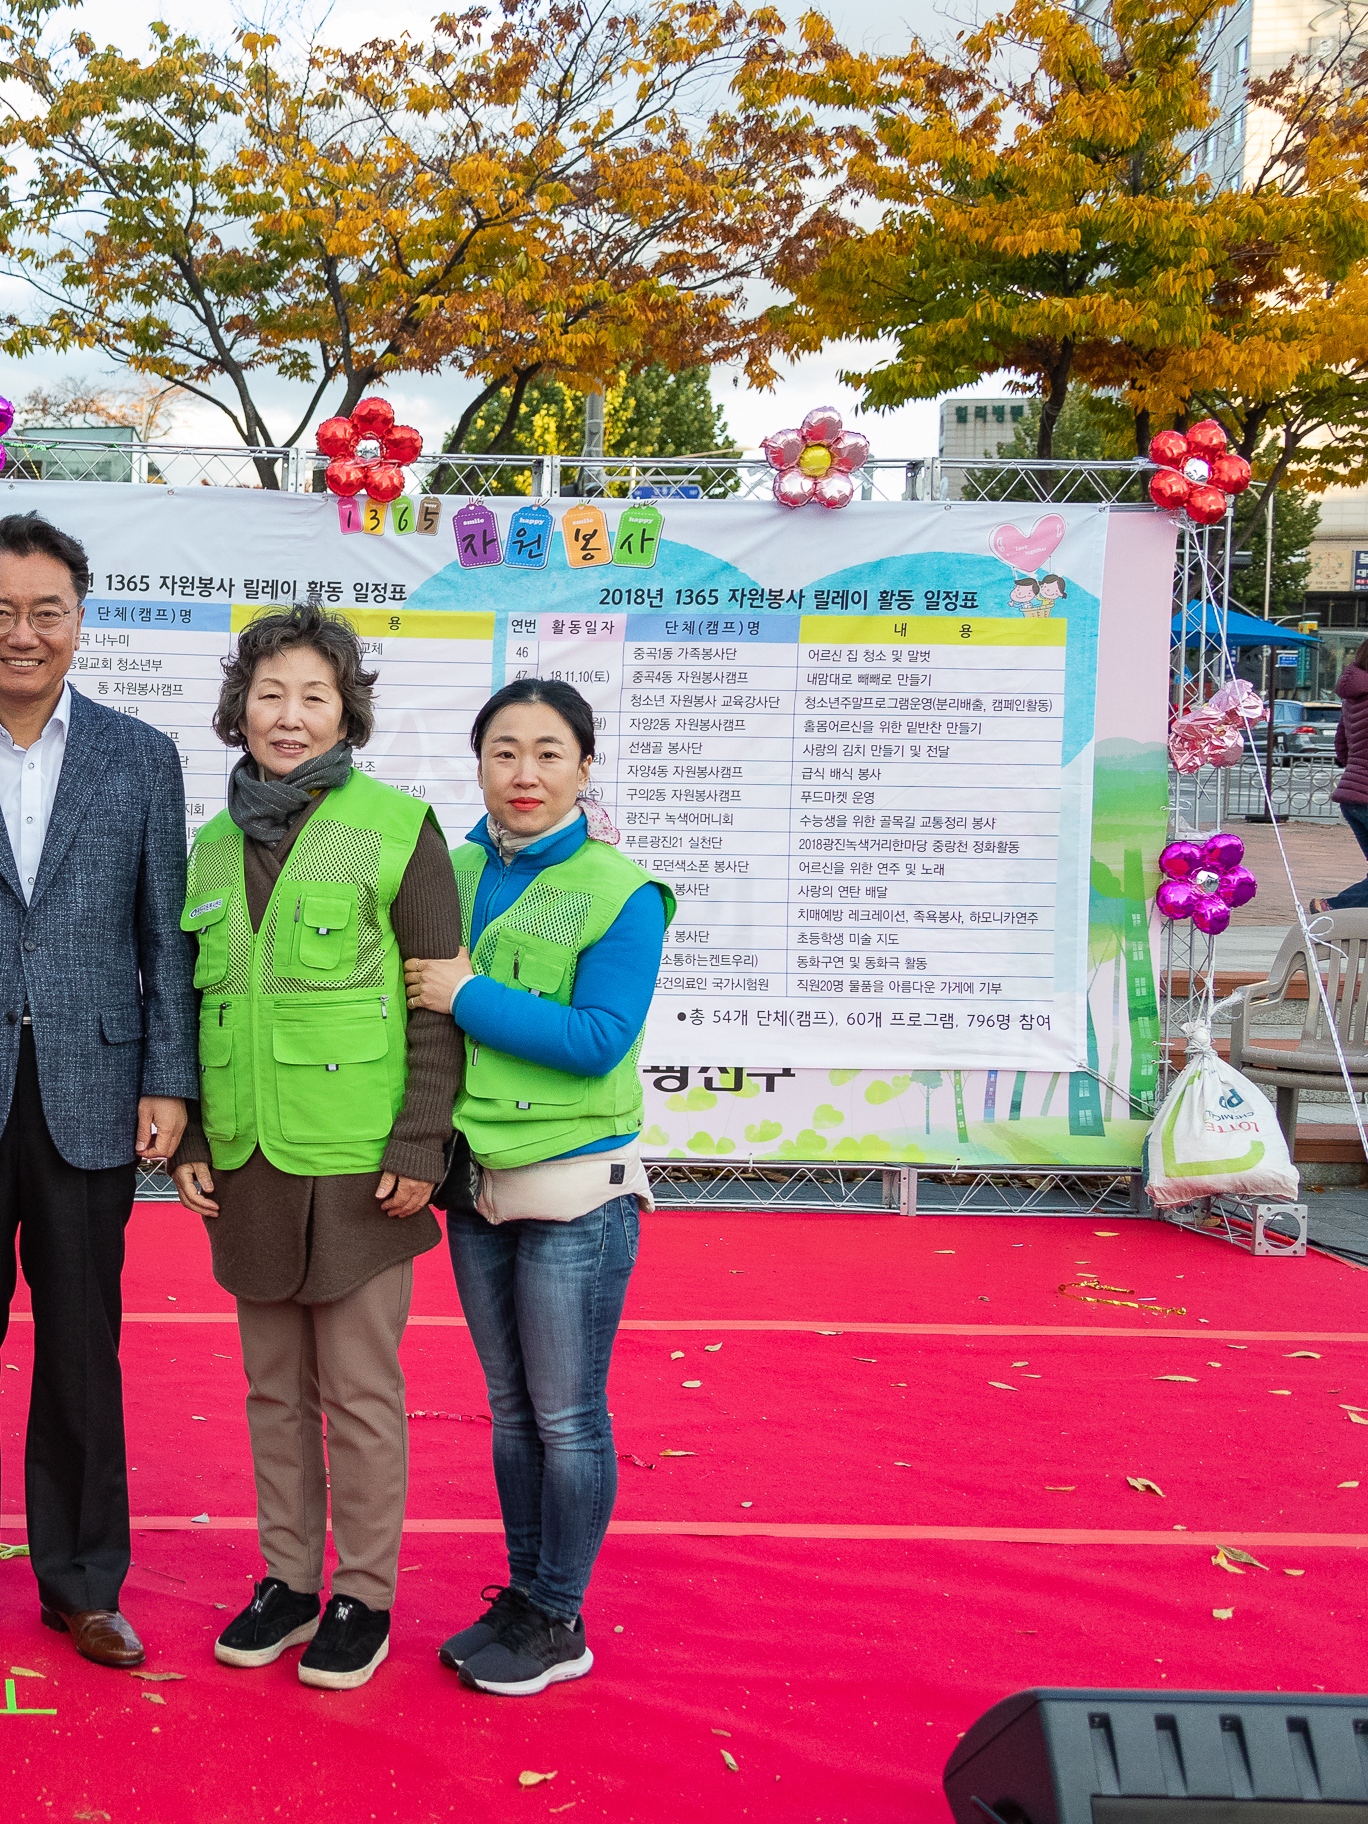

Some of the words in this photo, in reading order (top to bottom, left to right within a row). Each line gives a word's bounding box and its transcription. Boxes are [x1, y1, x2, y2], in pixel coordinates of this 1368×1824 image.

[106, 574, 150, 592] 1365
[159, 575, 235, 598] 자원봉사
[244, 579, 297, 600] 릴레이
[306, 580, 343, 604] 활동
[353, 582, 407, 603] 일정표
[599, 588, 663, 608] 2018년
[676, 589, 718, 605] 1365
[728, 588, 806, 610] 자원봉사
[814, 589, 867, 610] 릴레이
[878, 590, 915, 611] 활동
[924, 590, 979, 613] 일정표
[512, 619, 536, 633] 연번
[96, 634, 129, 647] 나누미
[516, 647, 528, 658] 46
[633, 648, 673, 660] 중곡1동
[677, 648, 737, 660] 가족봉사단
[809, 650, 842, 662] 어르신
[847, 650, 857, 662] 집
[863, 650, 886, 662] 청소
[892, 650, 902, 662] 및
[908, 650, 930, 662] 말벗
[117, 658, 162, 672] 청소년부
[807, 673, 852, 685] 내맘대로
[858, 673, 892, 686] 빼빼로
[898, 674, 931, 686] 만들기
[114, 682, 183, 696] 자원봉사캠프
[631, 694, 664, 707] 청소년
[670, 695, 717, 708] 자원봉사
[721, 695, 780, 708] 교육강사단
[804, 720, 874, 733] 홀몸어르신을
[879, 721, 902, 733] 위한
[907, 721, 942, 734] 밑반찬
[947, 722, 981, 735] 만들기
[629, 741, 663, 754] 선샘골
[668, 742, 703, 754] 봉사단
[801, 791, 847, 804] 푸드마켓
[852, 791, 874, 804] 운영
[626, 812, 660, 824] 광진구
[665, 813, 733, 826] 녹색어머니회
[800, 815, 847, 827] 수능생을
[852, 815, 875, 827] 위한
[880, 816, 915, 828] 골목길
[920, 816, 967, 829] 교통정리
[972, 817, 997, 830] 봉사
[626, 836, 682, 848] 푸른광진21
[688, 836, 723, 849] 실천단
[799, 839, 928, 852] 2018광진녹색거리한마당
[932, 840, 967, 853] 중랑천
[973, 841, 1020, 854] 정화활동
[652, 860, 709, 872] 모던색소폰
[714, 861, 749, 873] 봉사단
[798, 885, 832, 898] 사랑의
[838, 886, 861, 898] 연탄
[866, 886, 888, 898] 배달
[798, 909, 844, 922] 치매예방
[970, 911, 1038, 924] 하모니카연주
[797, 932, 843, 945] 초등학생
[849, 933, 872, 945] 미술
[877, 933, 899, 945] 지도
[712, 978, 768, 991] 국가시험원
[797, 979, 843, 992] 직원20명
[849, 980, 884, 993] 물품을
[889, 981, 935, 993] 아름다운
[940, 982, 974, 994] 가게에
[979, 982, 1002, 994] 기부
[713, 1010, 747, 1026] 54개
[847, 1012, 881, 1028] 60개
[967, 1014, 1010, 1030] 796명
[1019, 1014, 1050, 1030] 참여
[1204, 1121, 1260, 1133] LOTTE
